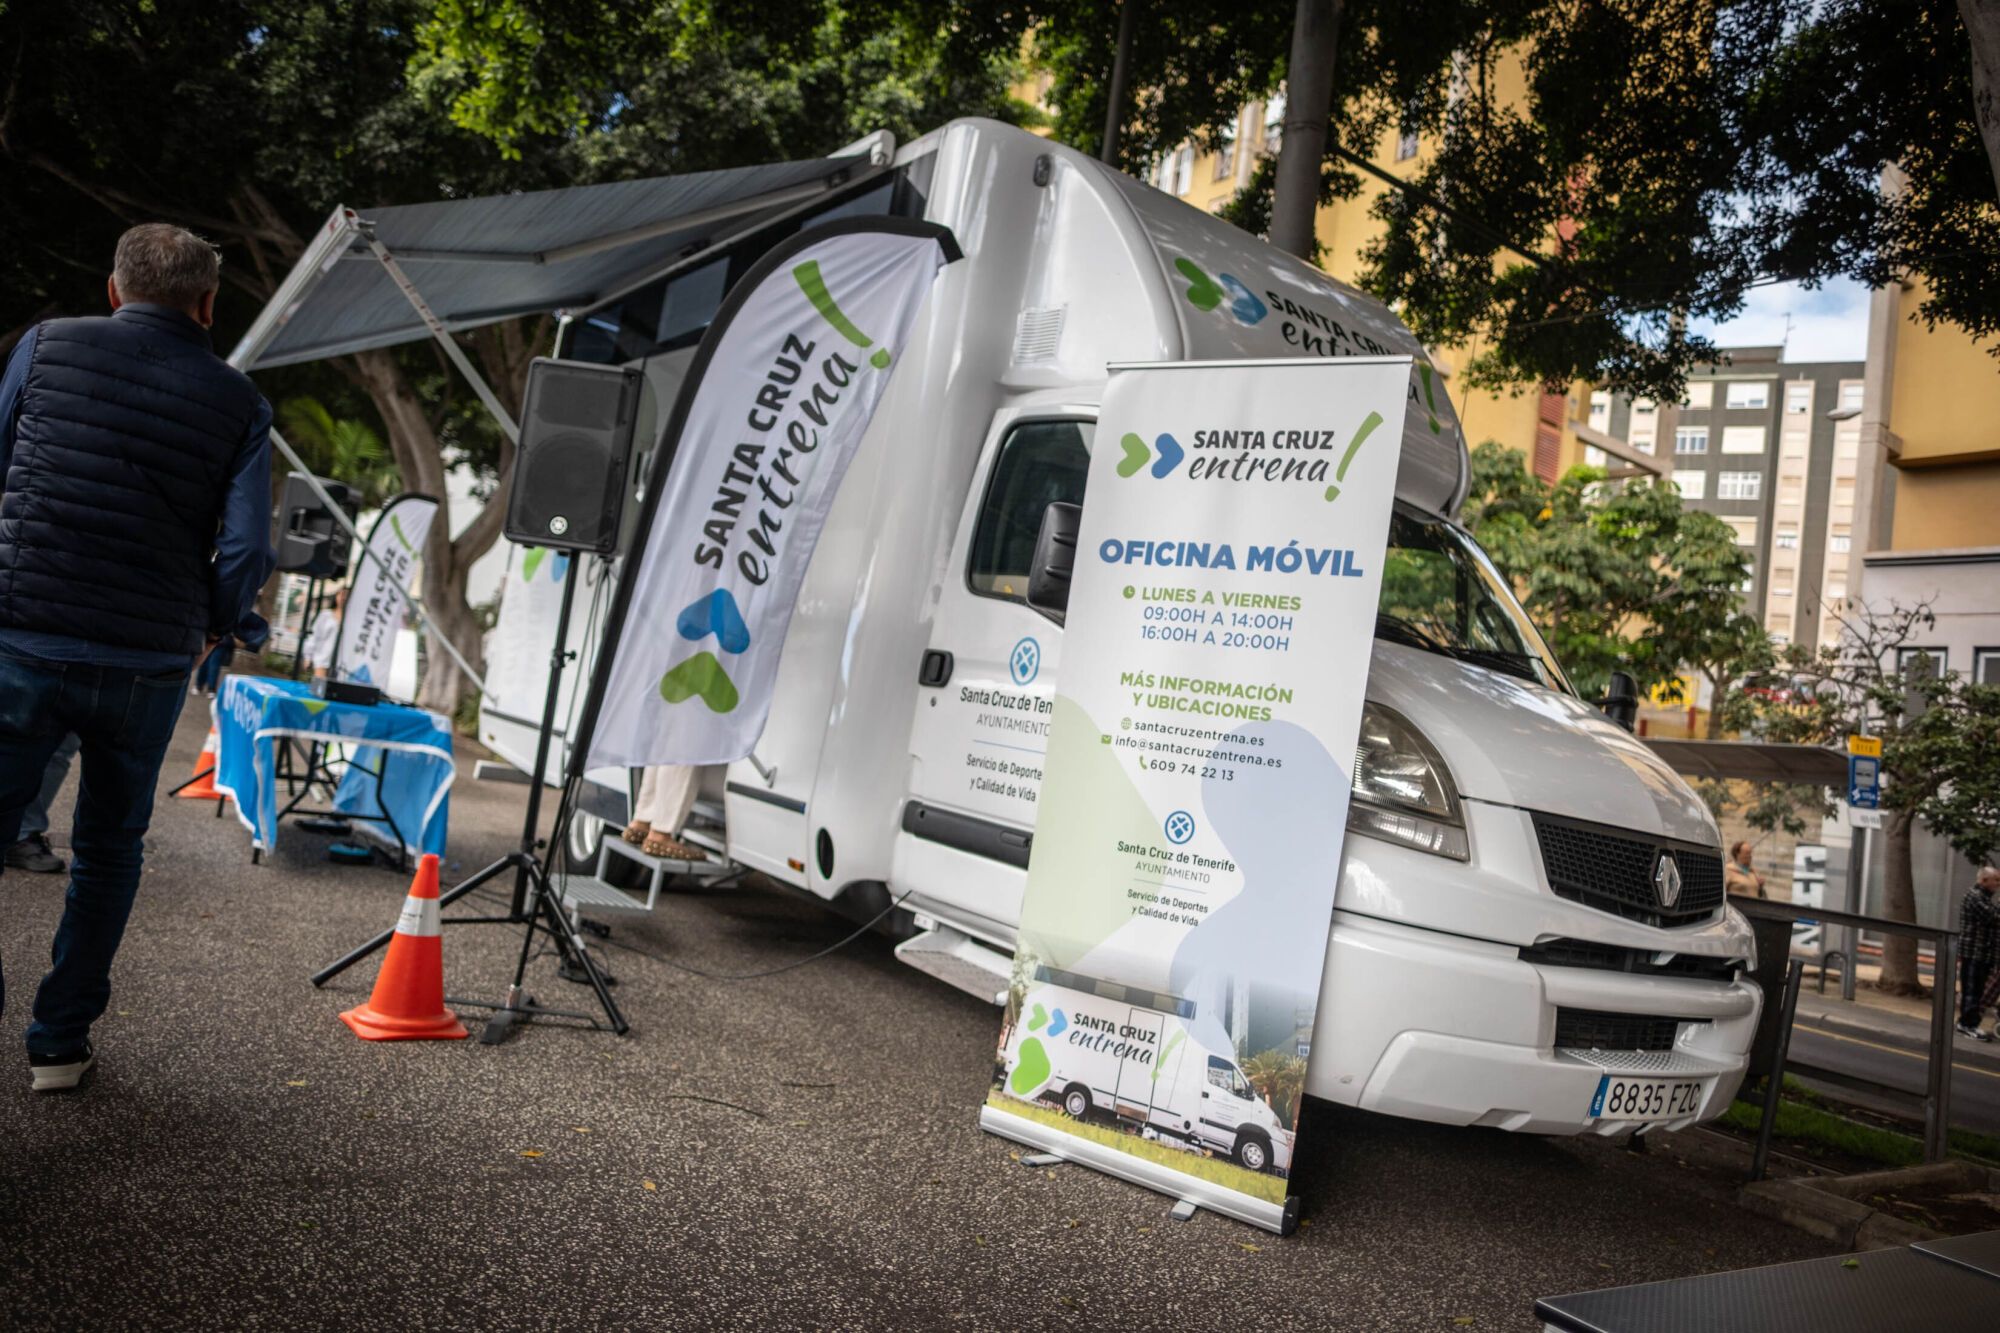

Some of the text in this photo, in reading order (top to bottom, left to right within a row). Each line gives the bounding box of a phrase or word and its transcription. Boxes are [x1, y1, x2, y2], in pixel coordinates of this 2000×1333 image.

[1265, 290, 1399, 356] SANTA CRU
[694, 332, 816, 569] SANTA CRUZ
[1193, 430, 1335, 450] SANTA CRUZ
[1099, 538, 1364, 577] OFICINA MÓVIL
[1142, 586, 1302, 611] LUNES A VIERNES
[1143, 606, 1293, 631] 09:00H A 14:00H
[1141, 626, 1290, 651] 16:00H A 20:00H
[960, 686, 989, 705] Santa
[991, 690, 1015, 709] Cruz
[1017, 694, 1030, 711] de
[1120, 670, 1293, 704] MÁS INFORMACIÓN
[1133, 693, 1272, 722] Y UBICACIONES
[1134, 720, 1265, 747] santacruzentrena.es
[1115, 735, 1282, 768] info@santacruzentrena.es
[966, 754, 1043, 781] Servicio de Deporte
[1150, 759, 1234, 781] 609 74 22 13
[970, 776, 1036, 802] y Calidad de Vida
[1117, 841, 1235, 872] Santa Cruz de Tenerife
[1135, 861, 1210, 884] AYUNTAMIENTO
[1127, 888, 1208, 914] Servicio de Deportes
[1138, 905, 1168, 920] Calidad
[1169, 911, 1180, 922] de
[1181, 914, 1199, 927] Vida
[1074, 1013, 1156, 1044] SANTA CRUZ
[1608, 1082, 1666, 1115] 8835
[1667, 1083, 1700, 1115] FZC
